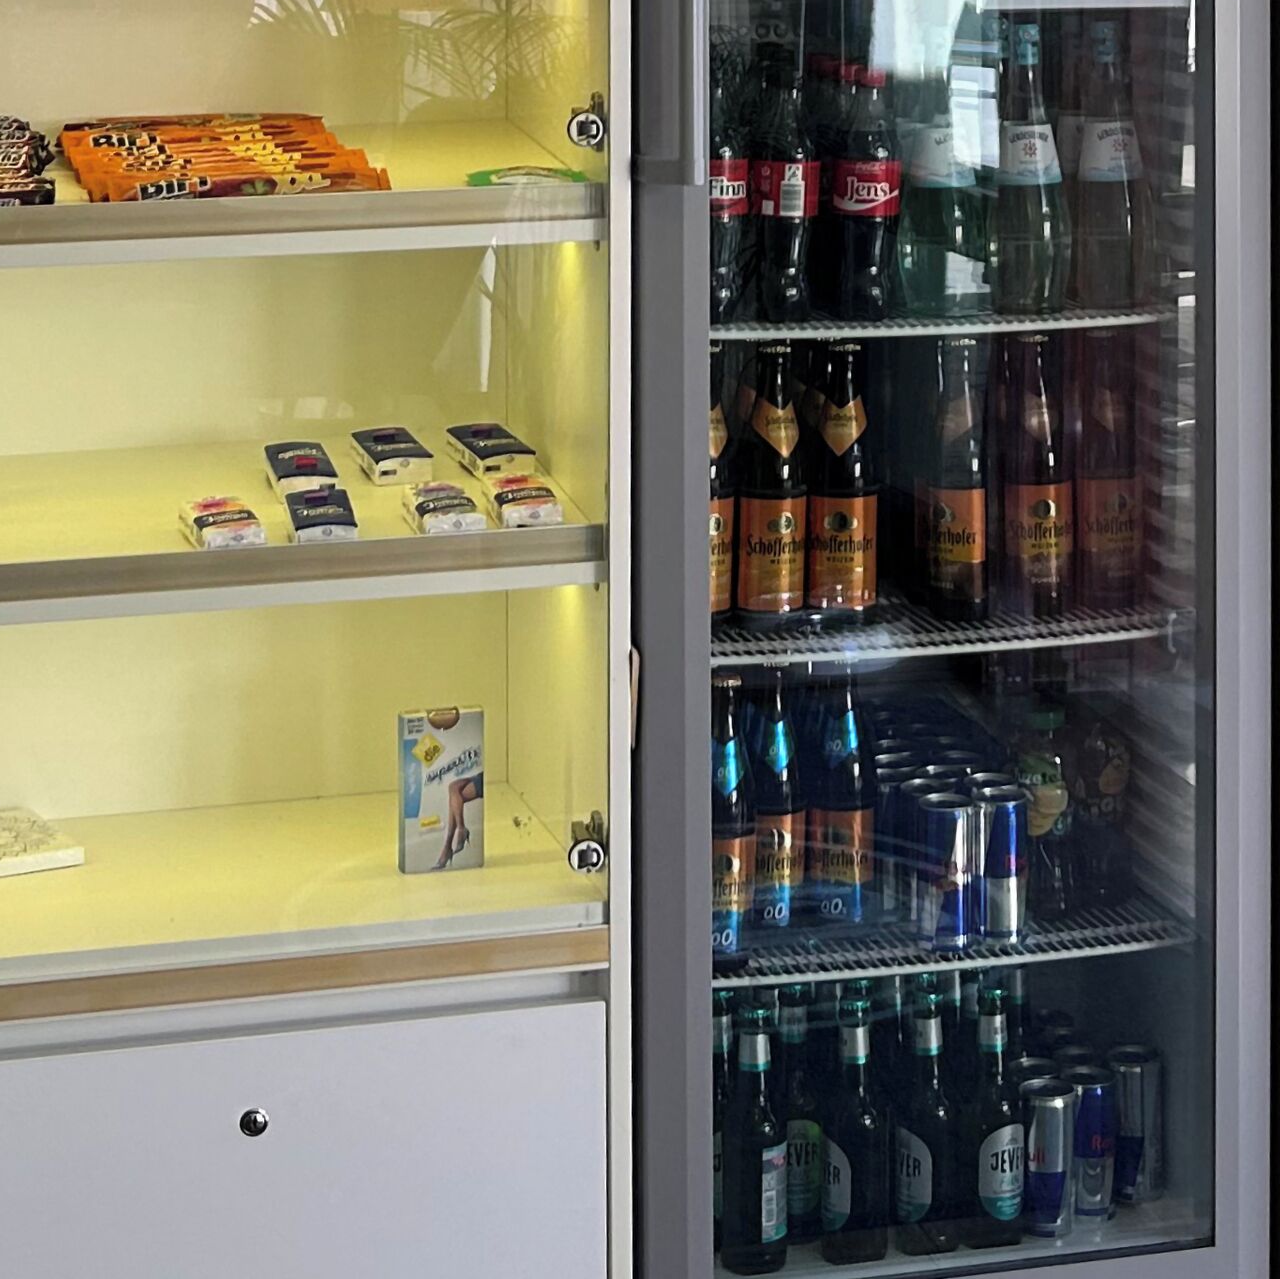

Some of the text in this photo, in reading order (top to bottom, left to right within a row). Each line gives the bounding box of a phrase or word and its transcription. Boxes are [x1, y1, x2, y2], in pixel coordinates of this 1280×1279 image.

[847, 177, 890, 201] Jens
[786, 1140, 820, 1167] EVER
[990, 1151, 1024, 1173] JEVE
